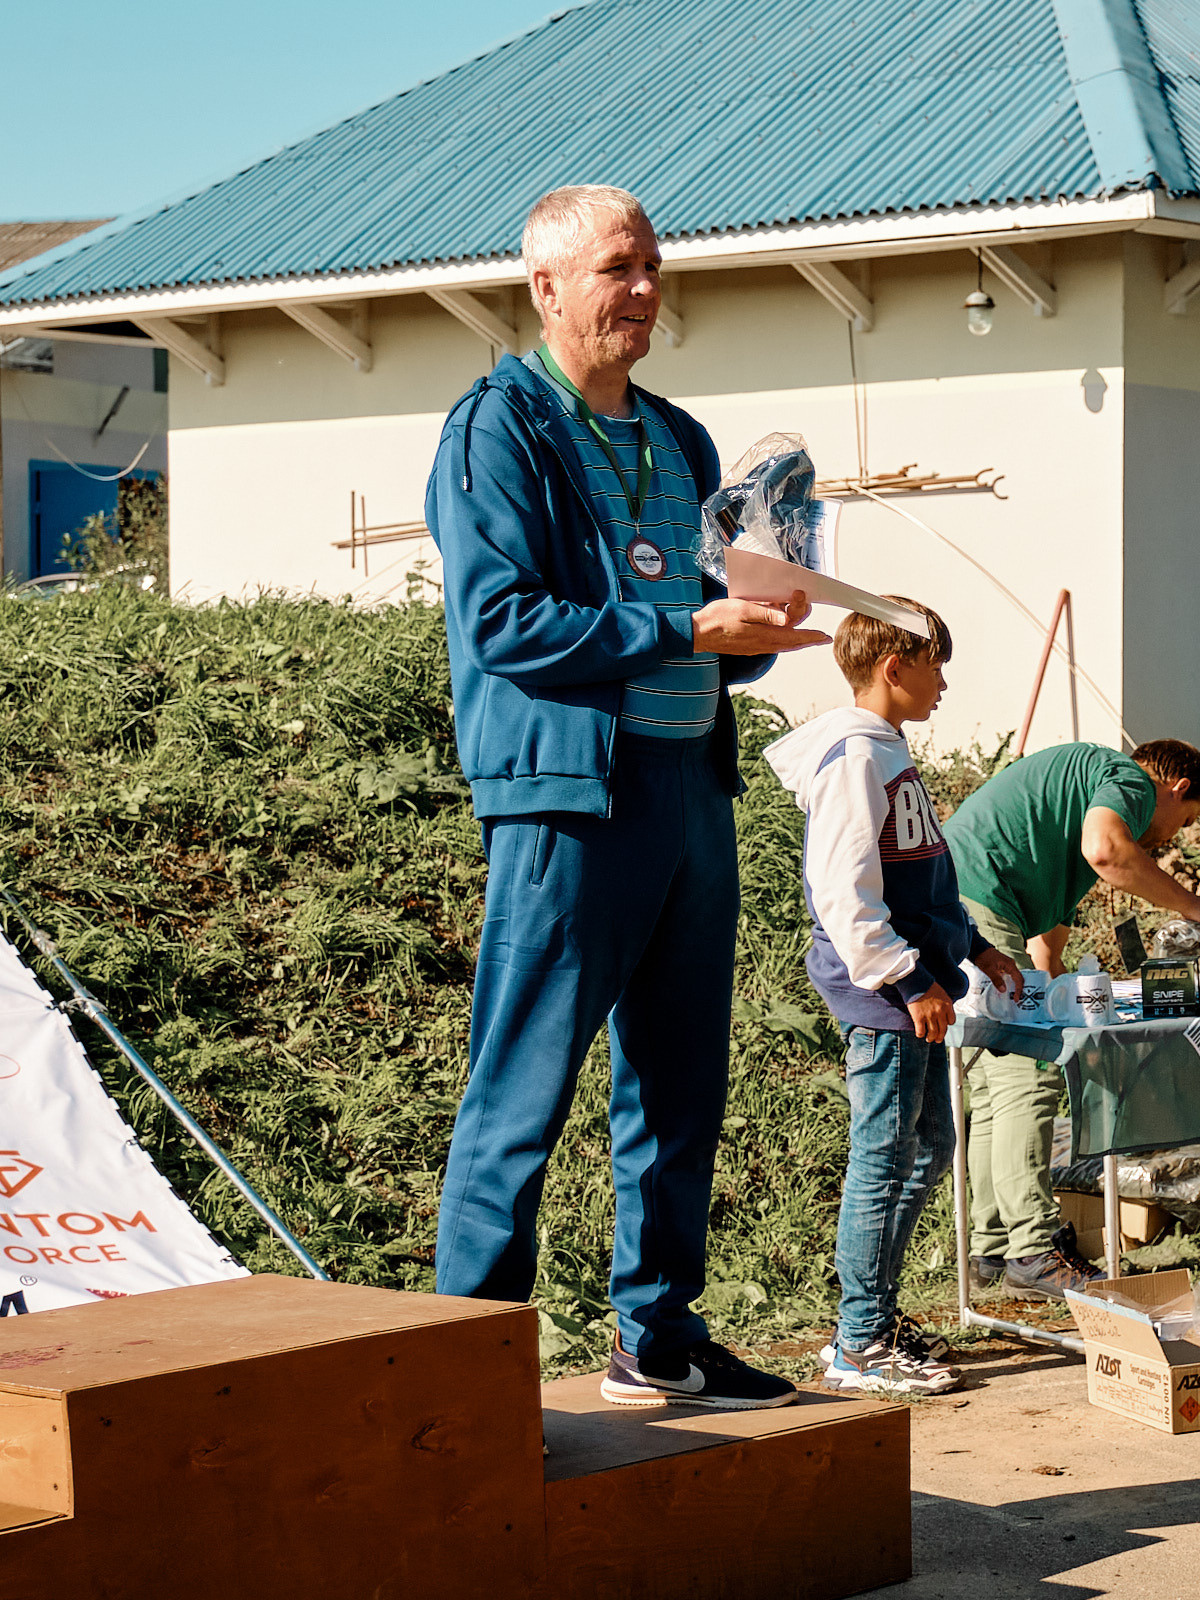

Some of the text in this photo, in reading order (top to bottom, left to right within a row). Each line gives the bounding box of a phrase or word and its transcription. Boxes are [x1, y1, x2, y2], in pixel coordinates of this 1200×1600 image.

[895, 777, 944, 851] BR
[1145, 967, 1189, 981] NRG
[1152, 989, 1185, 999] SNIPE
[0, 1210, 158, 1237] NTOM
[3, 1243, 127, 1265] ORCE
[1095, 1353, 1122, 1380] AZOT
[1164, 1406, 1170, 1425] UN
